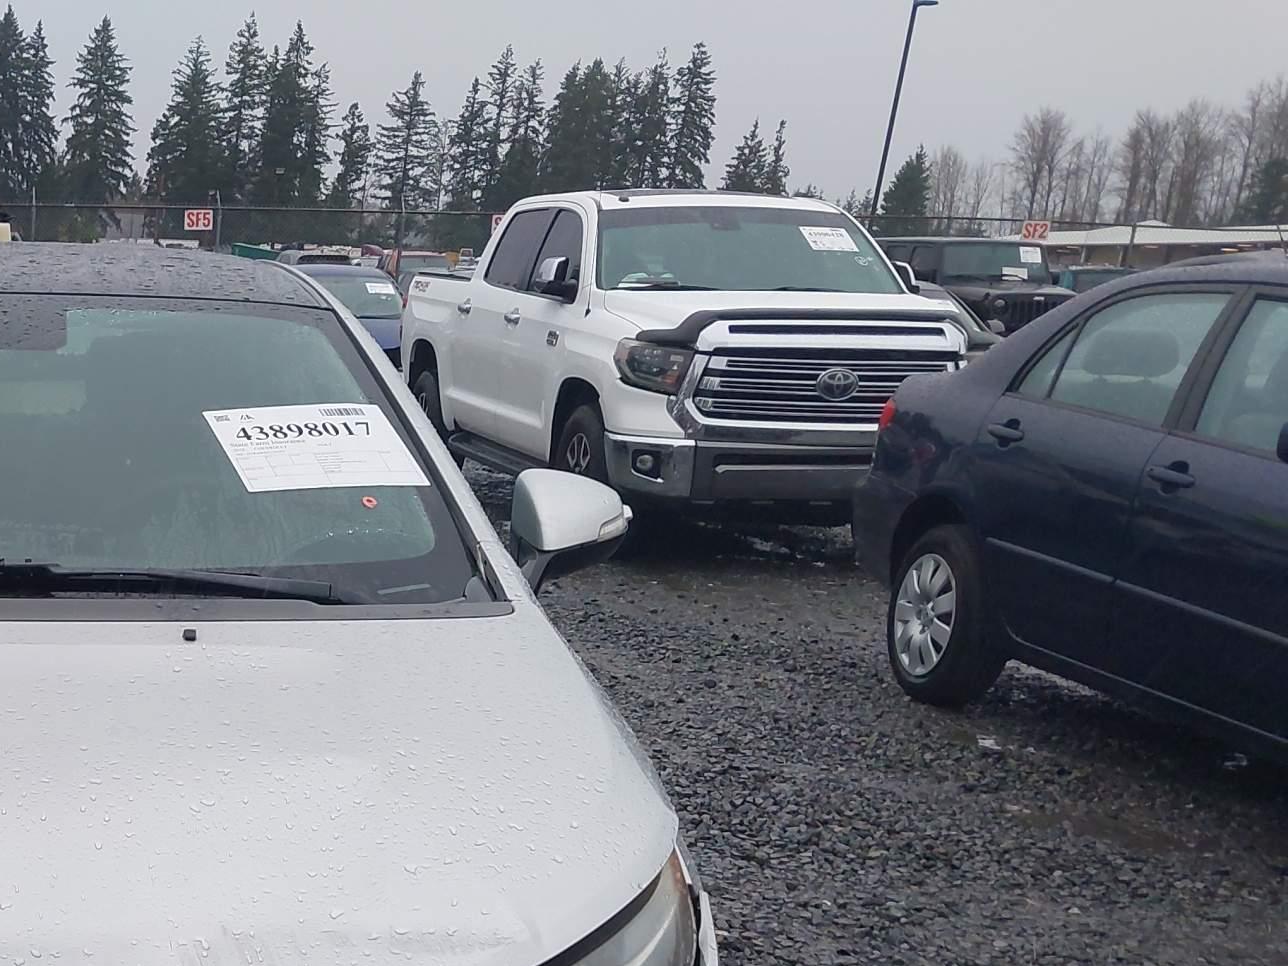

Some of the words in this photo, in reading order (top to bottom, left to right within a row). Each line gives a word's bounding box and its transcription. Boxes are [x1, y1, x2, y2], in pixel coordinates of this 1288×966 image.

[186, 211, 211, 228] SF5
[1023, 222, 1049, 239] SF2
[236, 421, 370, 441] 43898017
